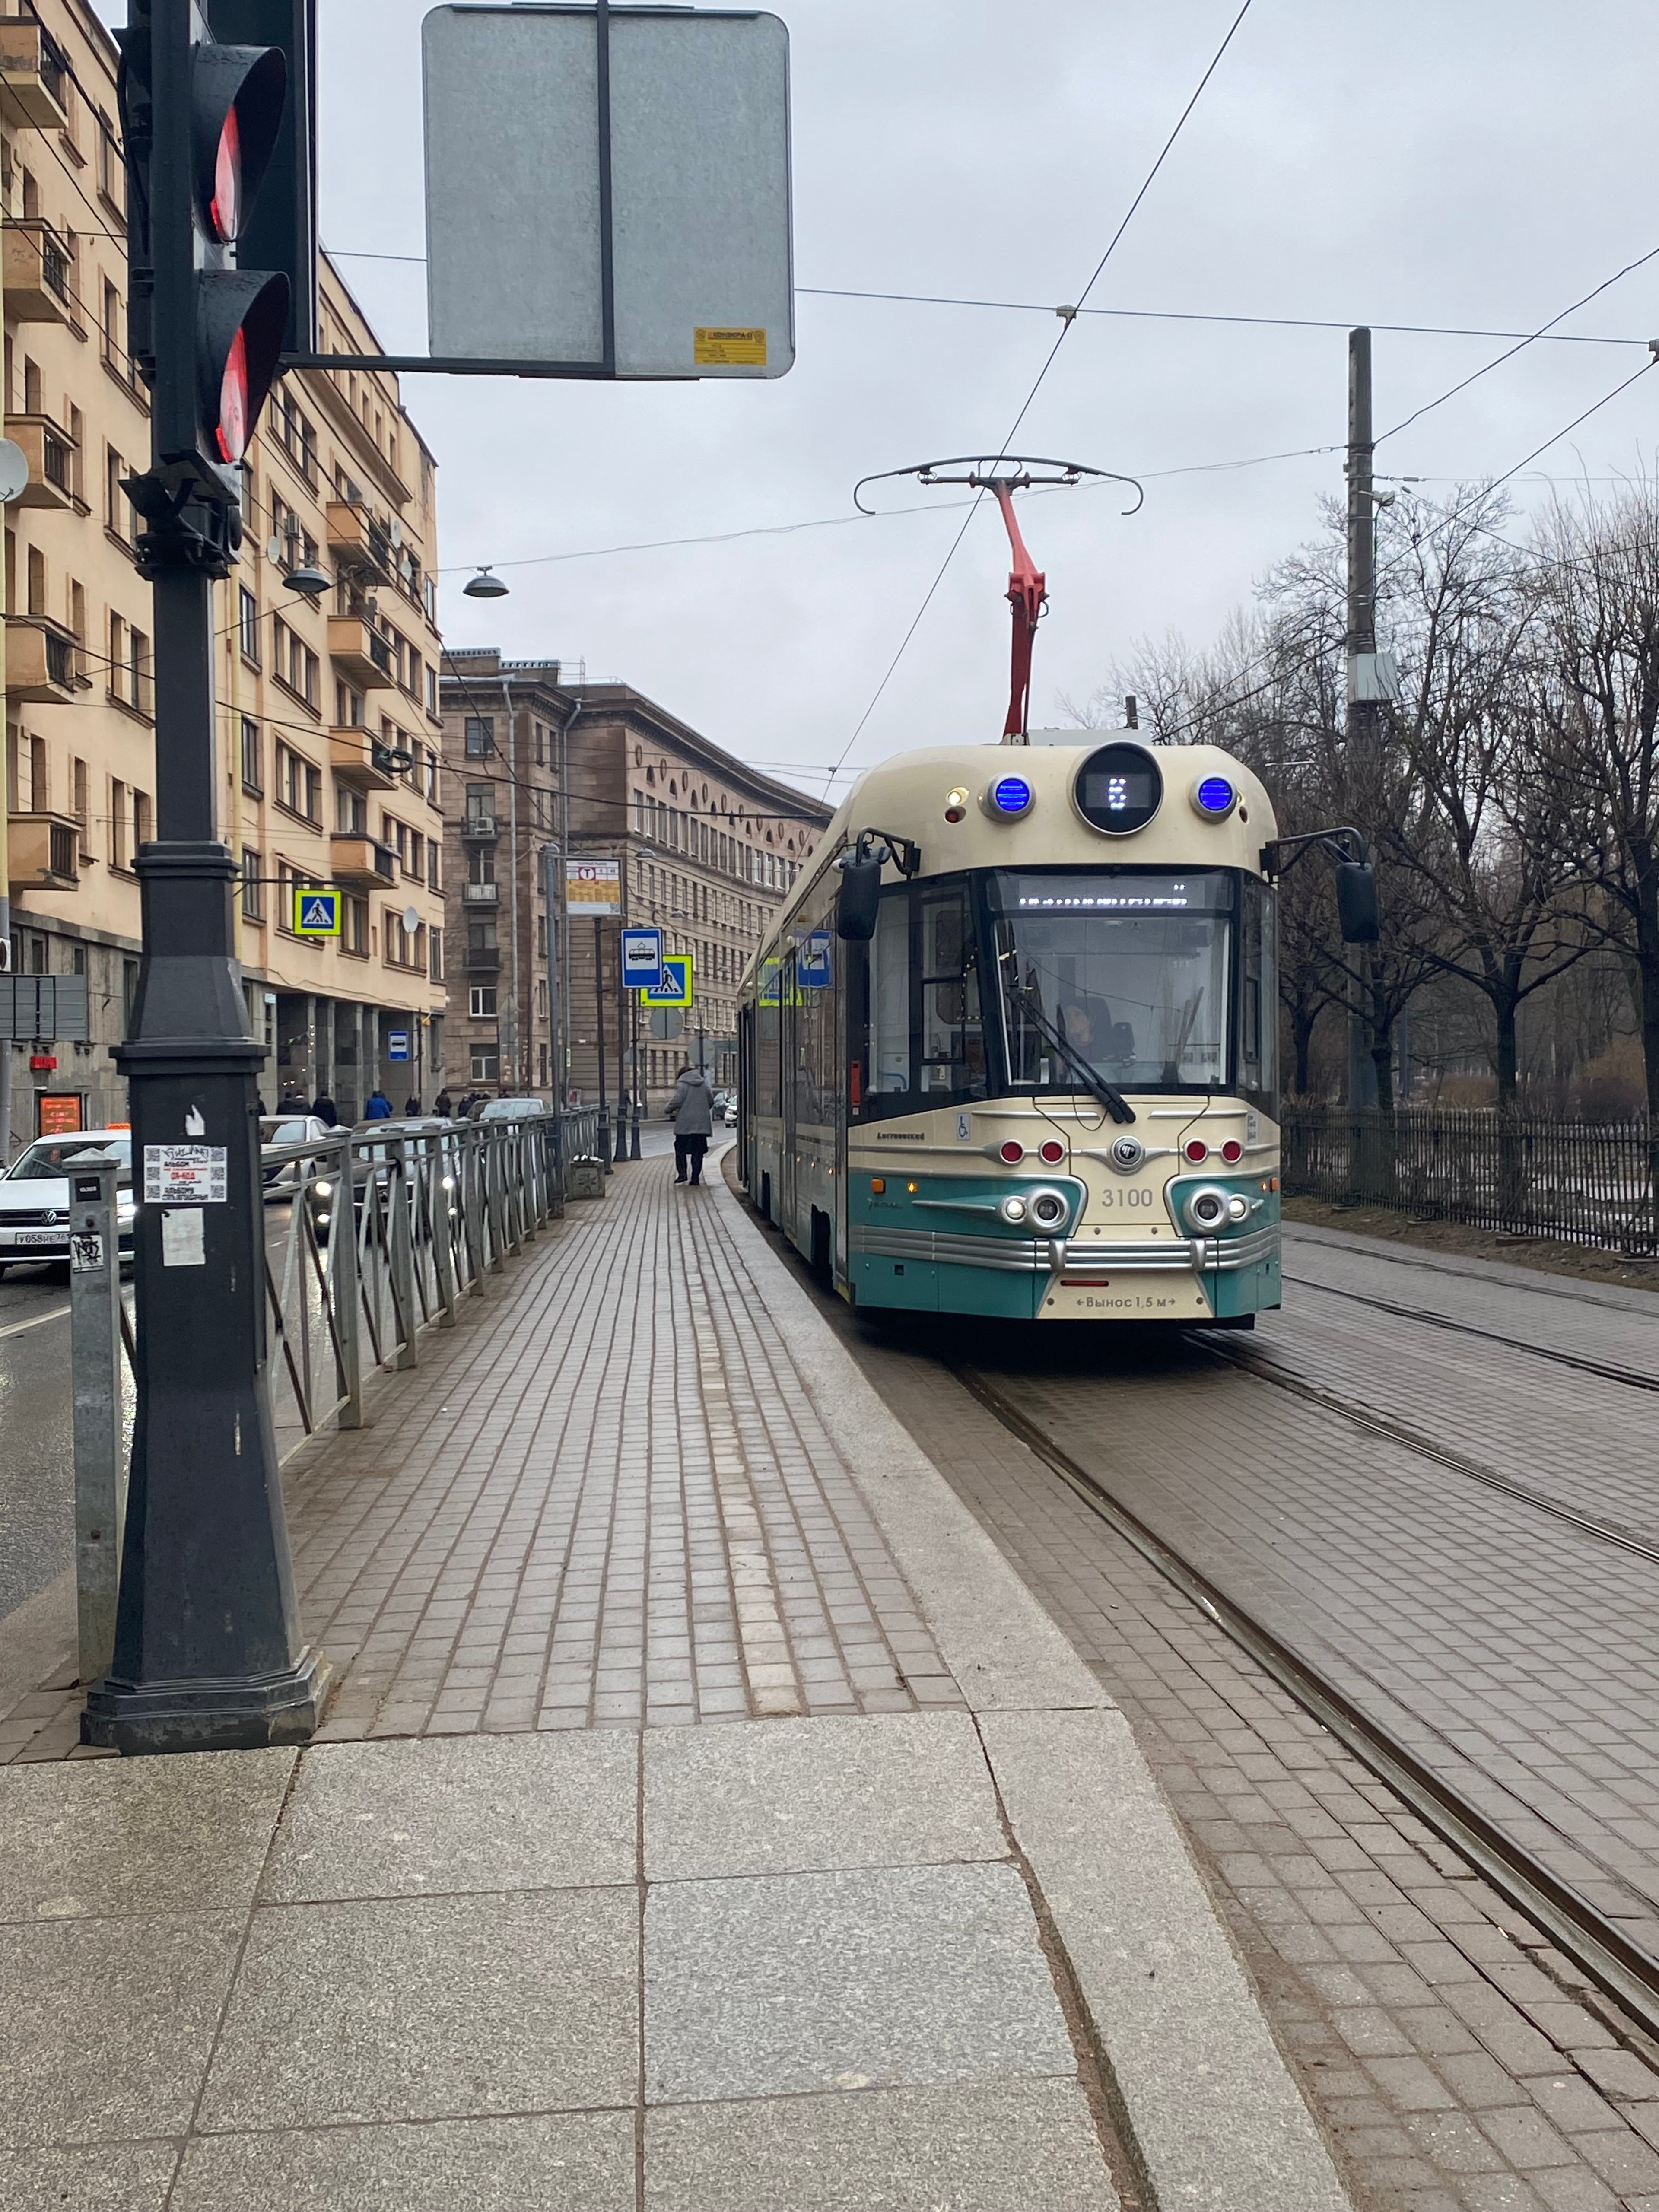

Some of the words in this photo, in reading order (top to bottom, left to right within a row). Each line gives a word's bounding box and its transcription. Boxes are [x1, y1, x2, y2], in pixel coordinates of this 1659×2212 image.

[1102, 1189, 1153, 1207] 3100
[1086, 1297, 1132, 1308] Вынос
[1136, 1297, 1153, 1308] 1,5
